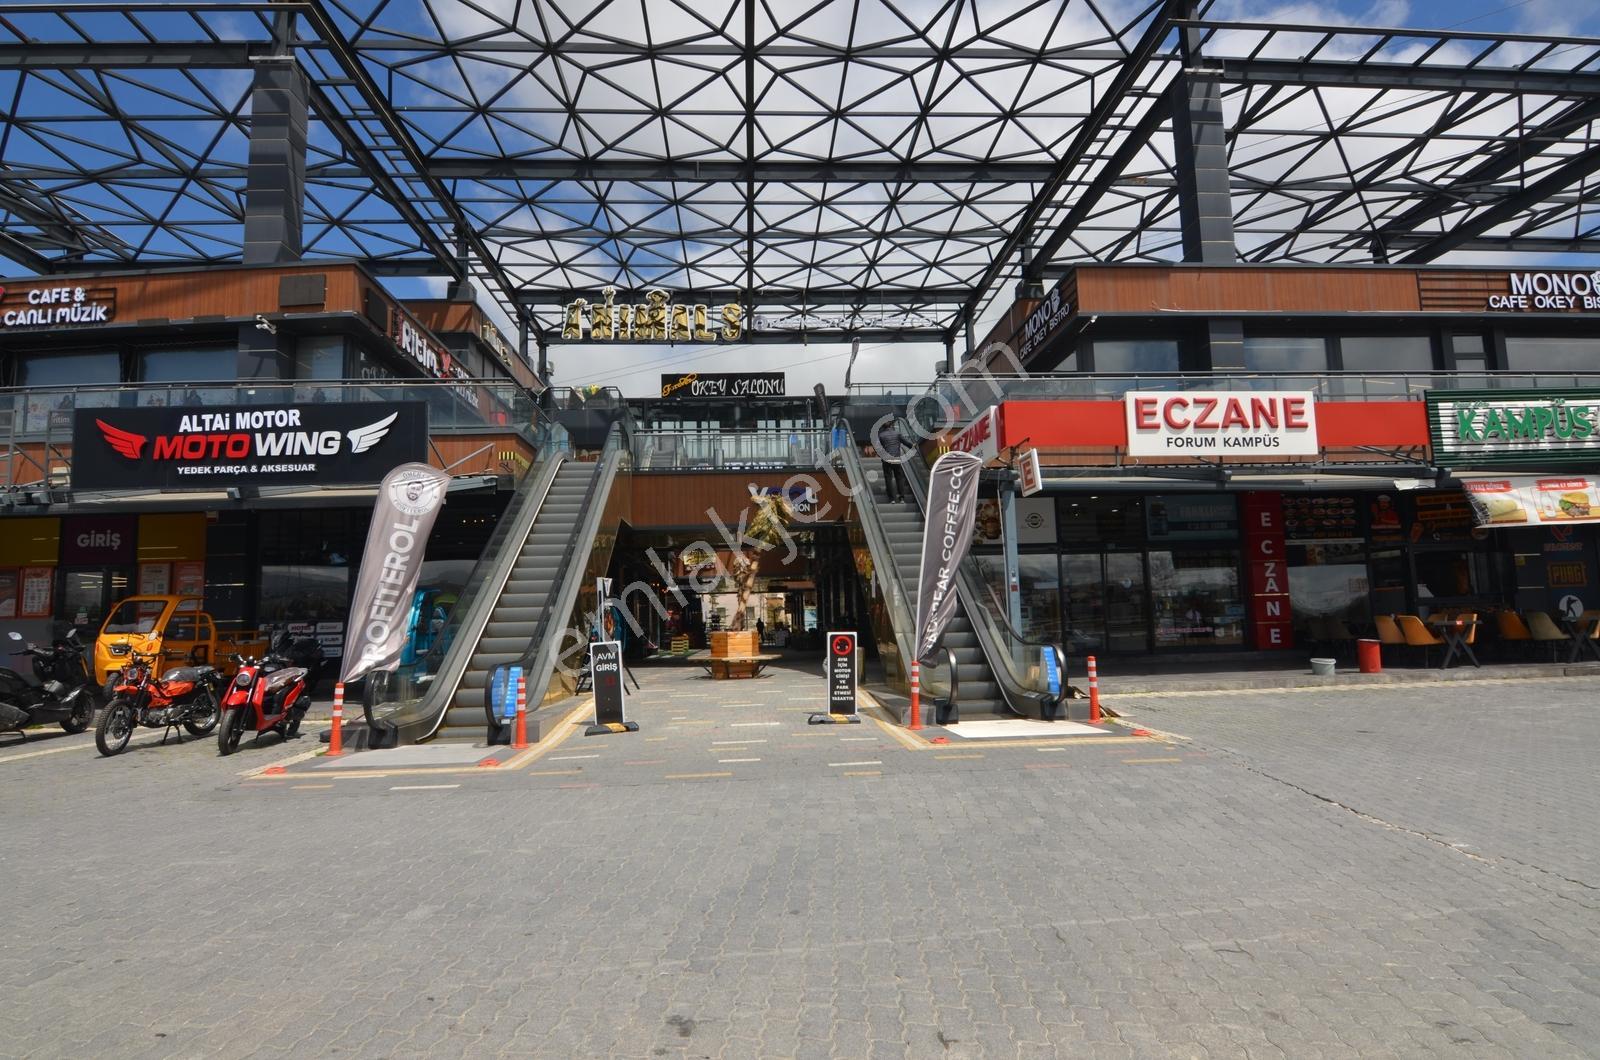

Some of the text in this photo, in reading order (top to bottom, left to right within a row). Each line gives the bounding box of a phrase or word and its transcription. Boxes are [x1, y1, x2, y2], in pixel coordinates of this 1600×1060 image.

[28, 287, 86, 304] CAFE &
[1488, 295, 1529, 309] CAFE
[1534, 295, 1576, 309] OKEY
[56, 302, 108, 323] MÜZİK
[1033, 324, 1048, 345] OKEY
[691, 378, 784, 396] OKEY SALONU
[236, 409, 301, 430] MOTOR
[1135, 397, 1309, 430] ECZANE
[1167, 434, 1280, 448] FORUM KAMPÜS
[177, 463, 316, 476] YEDEK PARÇA & AKSESUAR
[1022, 460, 1034, 487] E
[77, 529, 122, 550] GİRİŞ
[596, 663, 617, 672] GİRİŞ
